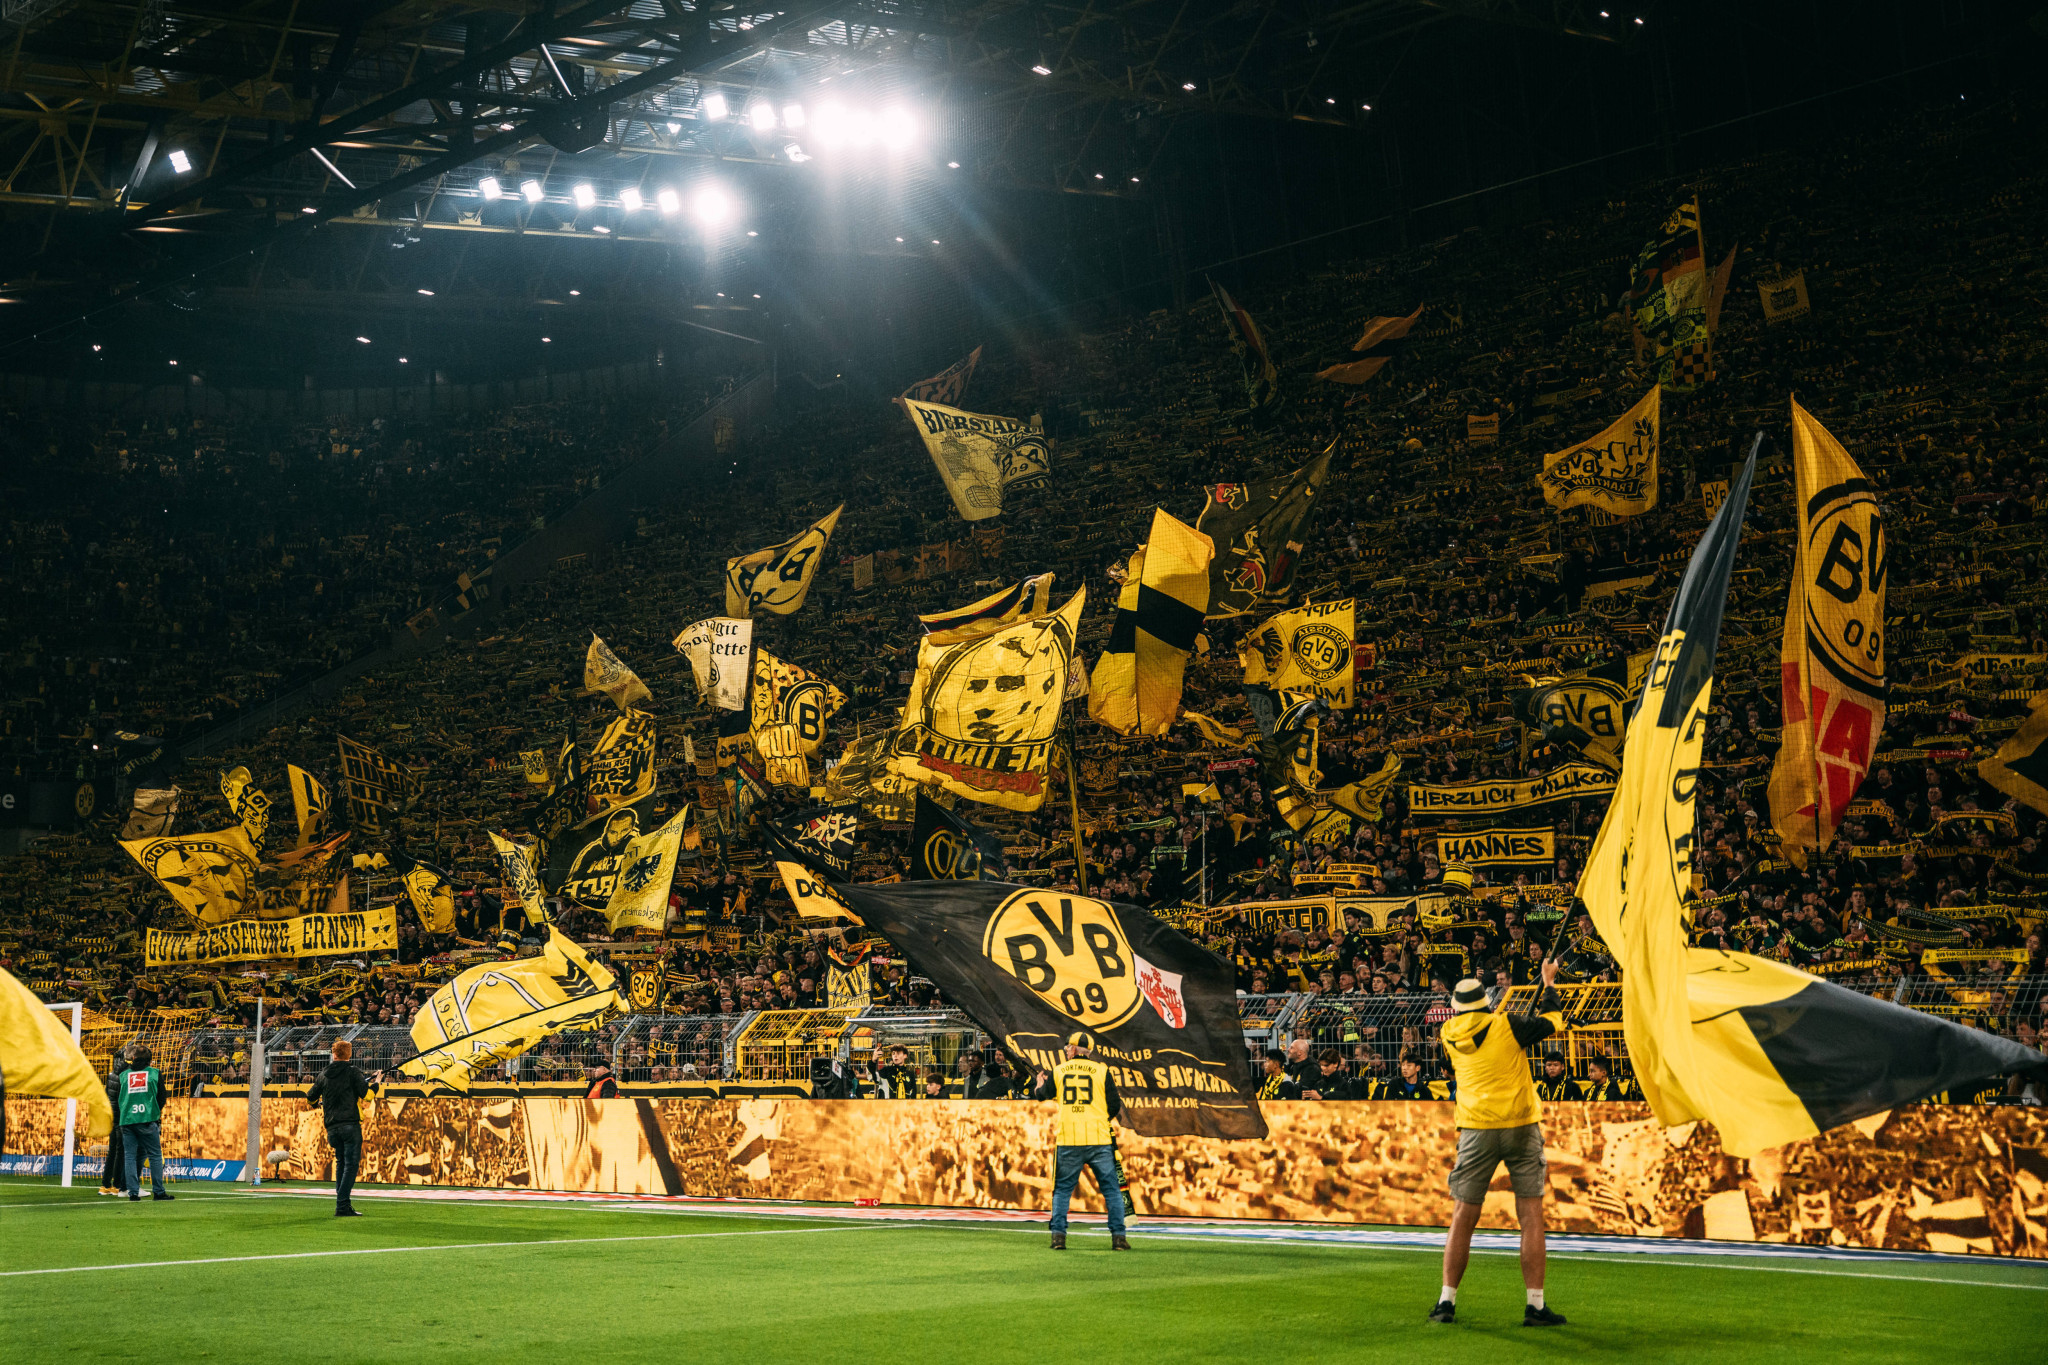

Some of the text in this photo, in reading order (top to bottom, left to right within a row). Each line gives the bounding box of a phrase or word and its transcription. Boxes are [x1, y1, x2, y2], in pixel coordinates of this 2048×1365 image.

[1414, 771, 1620, 807] HERZLICH WILLKOM
[1445, 835, 1545, 860] HANNES
[149, 914, 366, 962] GUTE BESSERUNG, ERNST!
[1004, 899, 1126, 992] BVB
[633, 972, 657, 998] BVB
[1061, 982, 1109, 1017] 09
[1097, 1044, 1152, 1062] FANCLUB
[1061, 1063, 1097, 1074] DORTMUND
[1062, 1074, 1094, 1105] 63
[1120, 1096, 1199, 1109] WALK ALONE
[131, 1103, 146, 1114] 30
